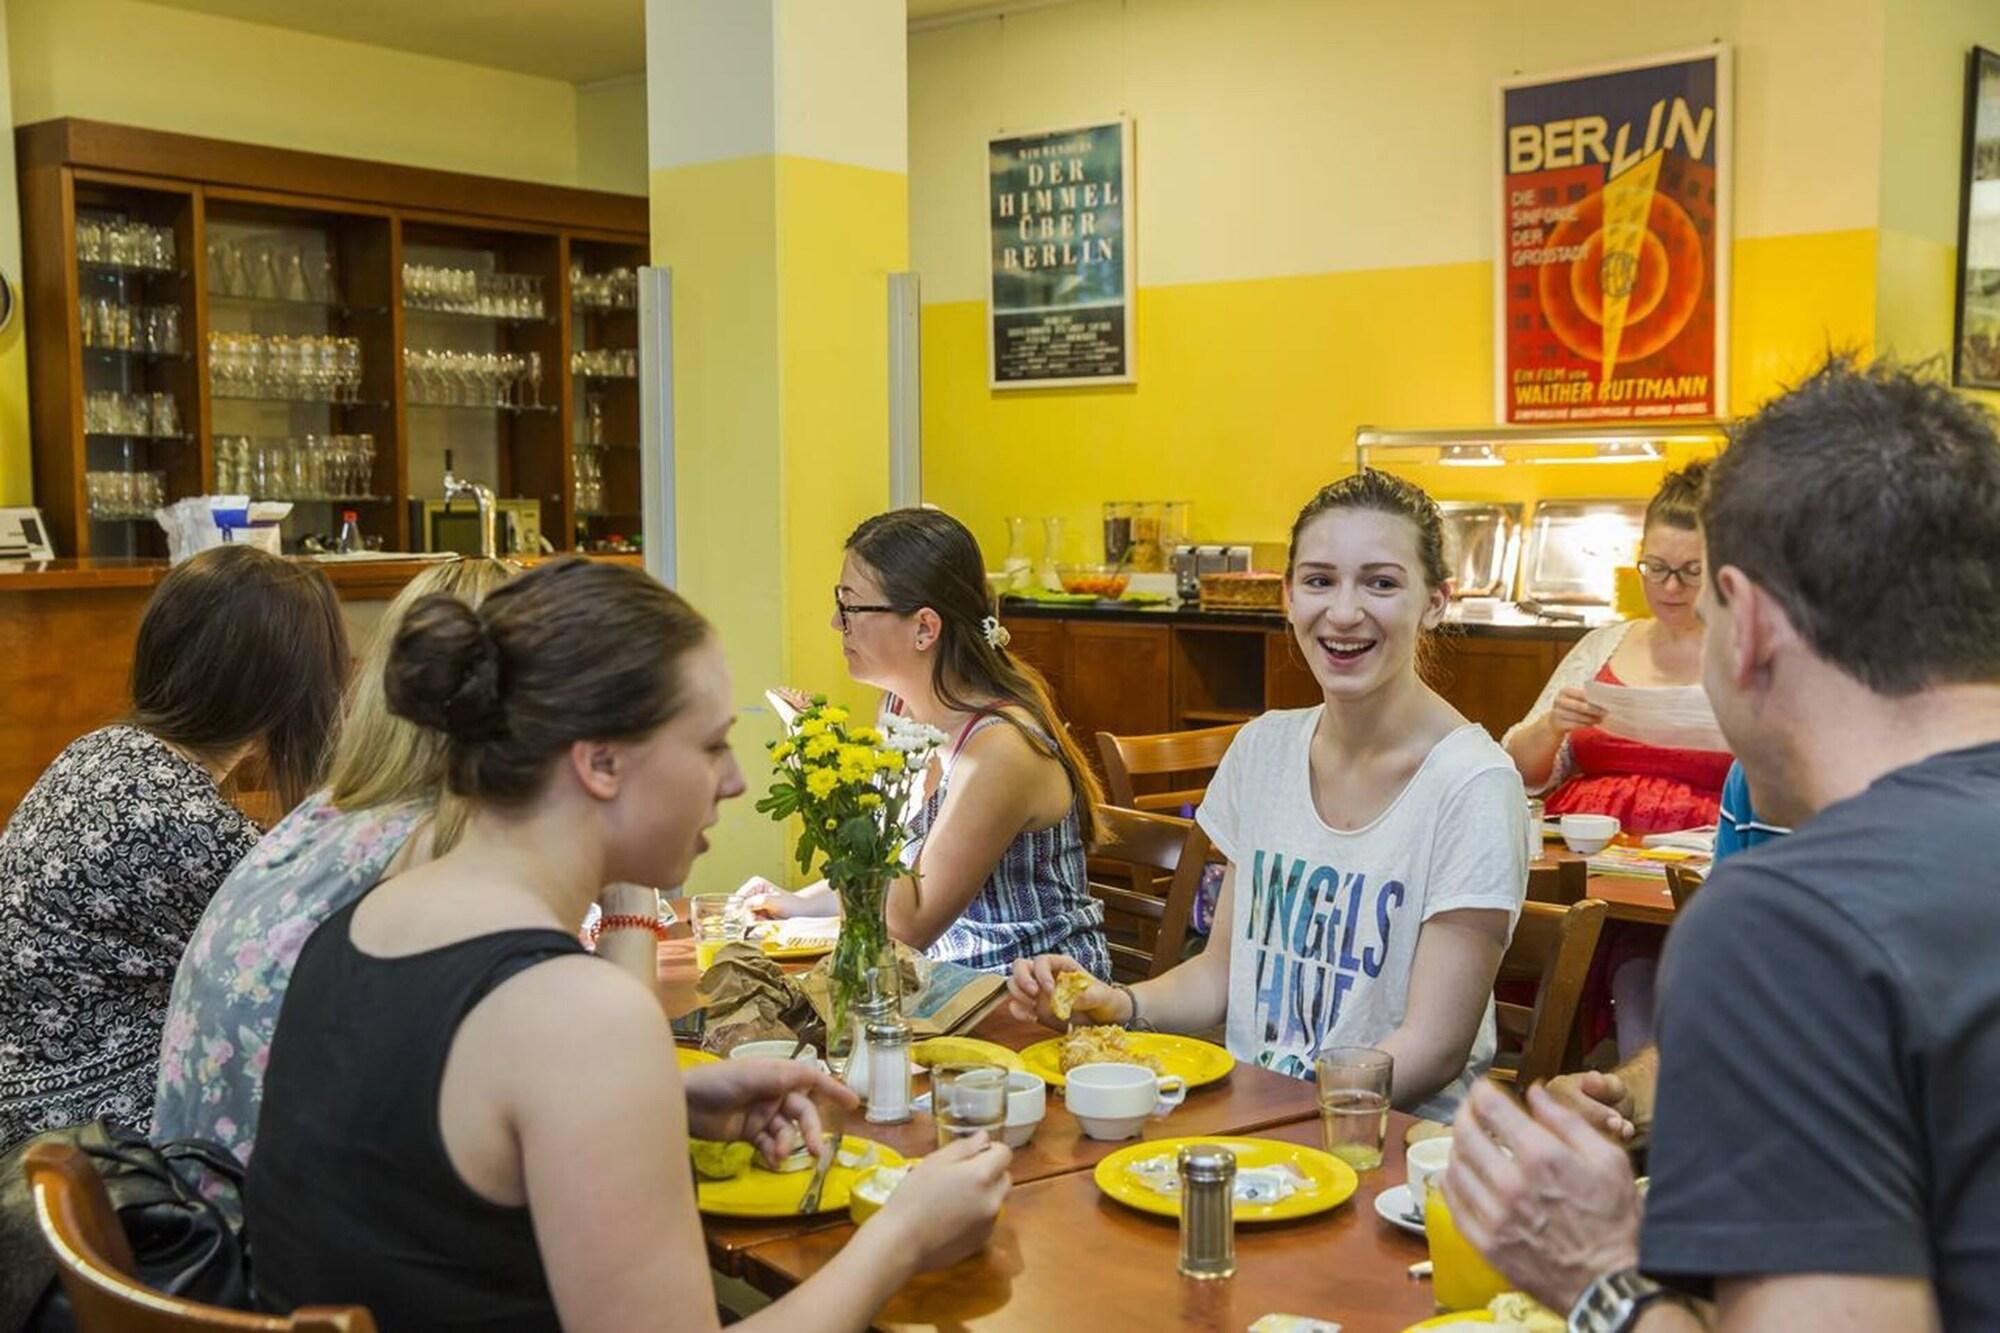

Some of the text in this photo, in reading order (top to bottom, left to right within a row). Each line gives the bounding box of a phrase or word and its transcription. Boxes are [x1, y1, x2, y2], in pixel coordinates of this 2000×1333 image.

[1508, 97, 1714, 182] BERLIN
[1028, 158, 1085, 187] DER
[999, 181, 1119, 218] HIMMEL
[1511, 187, 1536, 208] DIE
[1018, 211, 1097, 242] ÜBER
[1512, 227, 1544, 248] DER
[1003, 236, 1113, 272] BERLIN
[1513, 375, 1709, 406] WALTHER RUTTMANN
